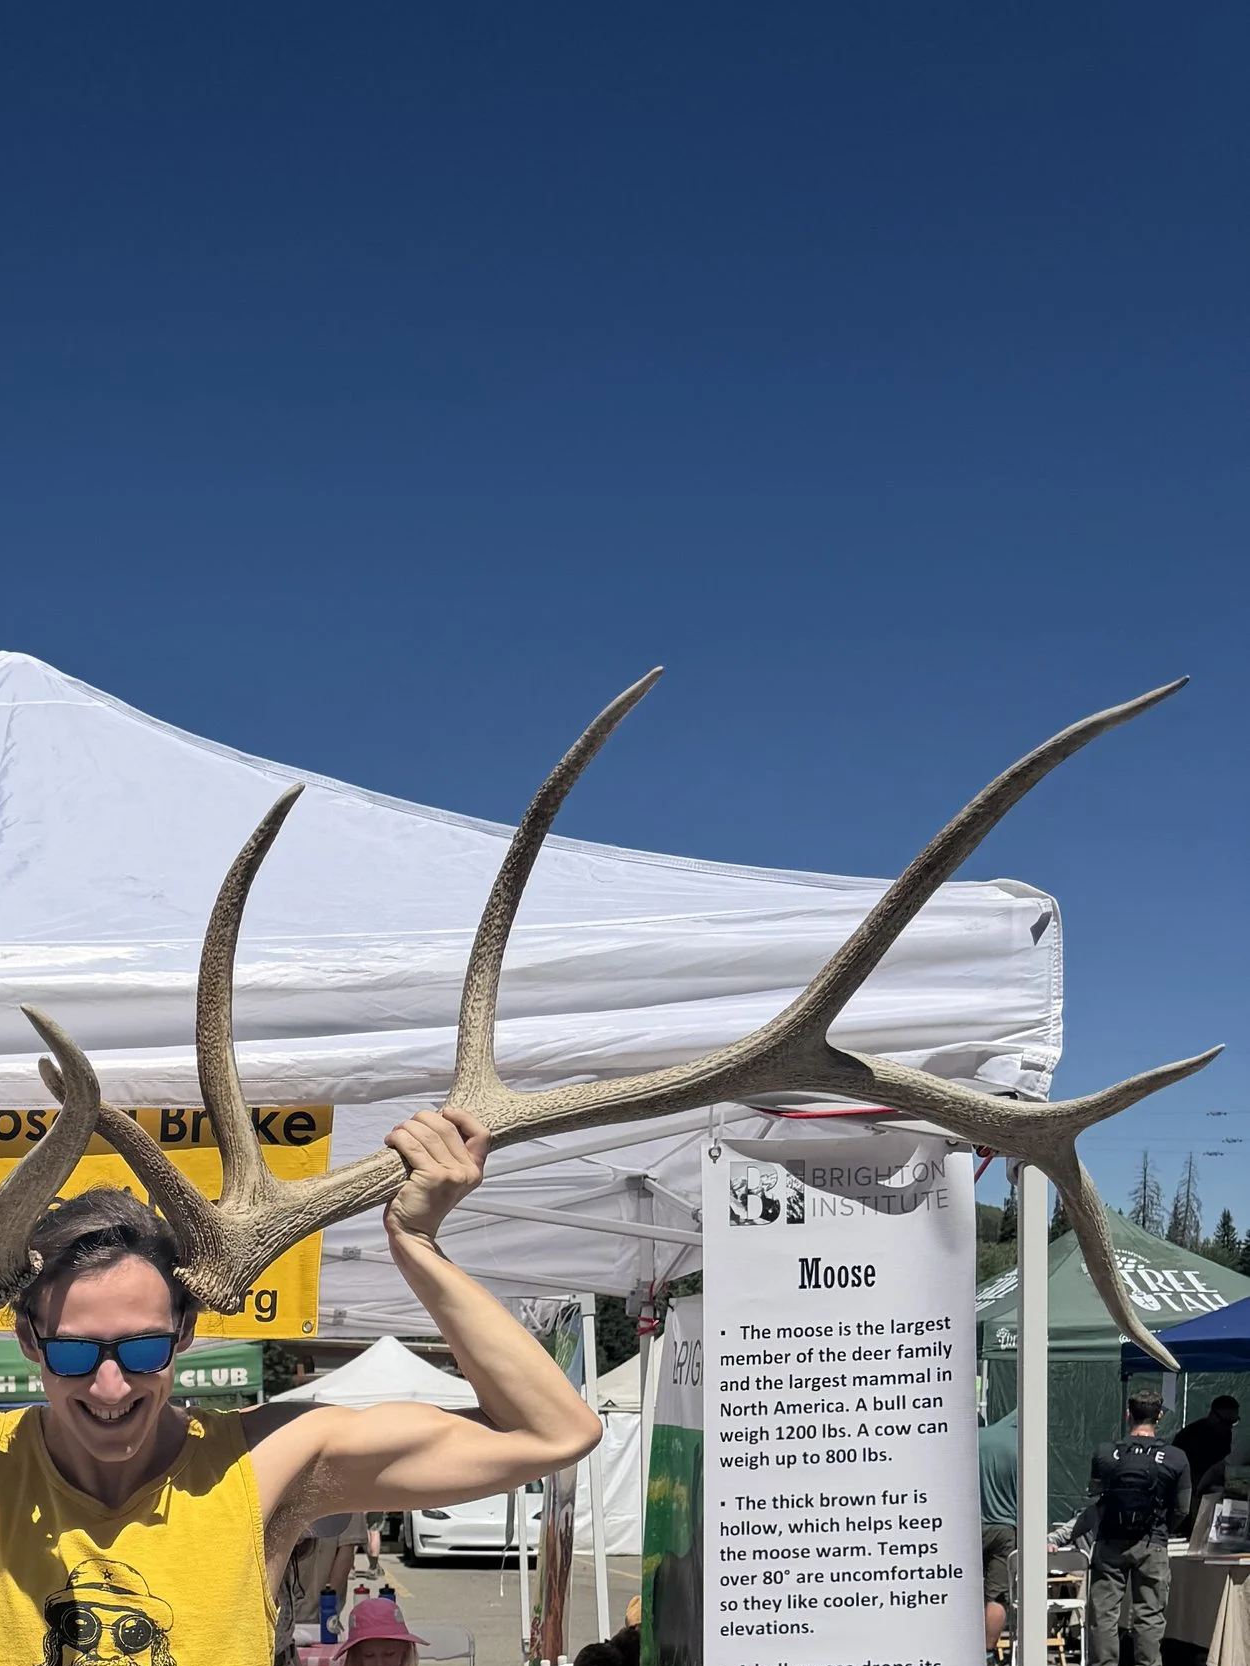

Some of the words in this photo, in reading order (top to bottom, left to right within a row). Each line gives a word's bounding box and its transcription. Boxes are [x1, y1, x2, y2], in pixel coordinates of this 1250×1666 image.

[812, 1160, 946, 1189] BRIGHTON
[812, 1188, 949, 1218] INSTITUTE
[798, 1257, 876, 1289] Moose
[739, 1324, 771, 1340] The
[777, 1326, 833, 1339] moose
[838, 1321, 851, 1336] is
[856, 1320, 885, 1336] the
[891, 1316, 951, 1336] largest
[720, 1349, 791, 1366] member
[796, 1347, 814, 1363] of
[818, 1347, 847, 1363] the
[852, 1346, 892, 1361] deer
[896, 1341, 953, 1359] family
[179, 1368, 248, 1387] CLUB
[720, 1376, 750, 1392] and
[755, 1375, 783, 1390] the
[789, 1374, 847, 1392] largest
[852, 1367, 931, 1387] mammal
[937, 1367, 952, 1382] in
[720, 1401, 768, 1417] North
[773, 1399, 849, 1415] America.
[855, 1397, 868, 1412] A
[873, 1395, 906, 1411] bull
[912, 1396, 943, 1409] can
[719, 1426, 769, 1445] weigh
[775, 1425, 817, 1440] 1200
[822, 1423, 851, 1439] lbs.
[857, 1423, 870, 1437] A
[874, 1424, 912, 1436] cow
[917, 1422, 948, 1435] can
[719, 1451, 770, 1470] weigh
[775, 1454, 797, 1469] up
[802, 1451, 820, 1465] to
[825, 1448, 857, 1464] 800
[863, 1447, 892, 1462] lbs.
[734, 1495, 767, 1511] The
[771, 1493, 814, 1509] thick
[820, 1492, 876, 1508] brown
[881, 1490, 908, 1505] fur
[913, 1489, 928, 1504] is
[720, 1520, 783, 1537] hollow,
[788, 1517, 840, 1534] which
[846, 1516, 893, 1534] helps
[898, 1515, 943, 1532] keep
[719, 1546, 747, 1562] the
[752, 1547, 811, 1560] moose
[815, 1545, 872, 1558] warm.
[877, 1541, 938, 1558] Temps
[720, 1574, 758, 1587] over
[762, 1569, 790, 1585] 80°
[796, 1572, 824, 1584] are
[830, 1563, 963, 1583] uncomfortable
[720, 1600, 738, 1612] so
[742, 1595, 782, 1613] they
[787, 1594, 818, 1609] like
[823, 1592, 884, 1609] cooler,
[890, 1590, 948, 1609] higher
[720, 1620, 814, 1637] elevations.
